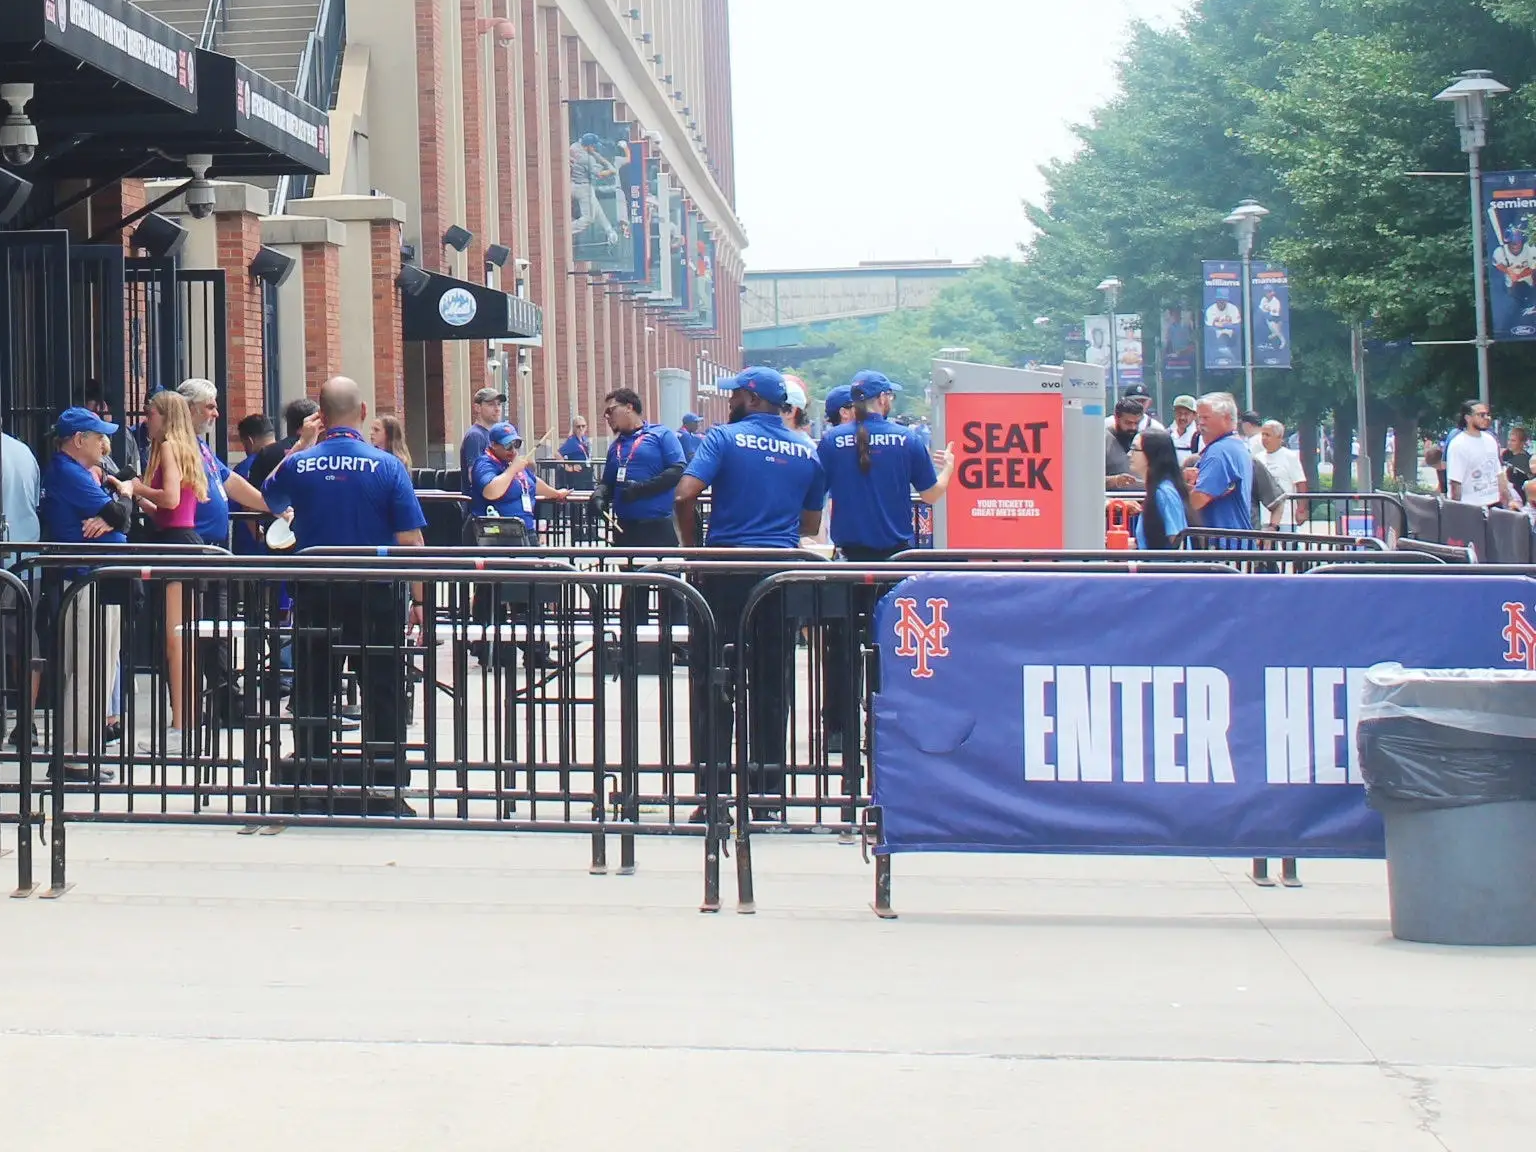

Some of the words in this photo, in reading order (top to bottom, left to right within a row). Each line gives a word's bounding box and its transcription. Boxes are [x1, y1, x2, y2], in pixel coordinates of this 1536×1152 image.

[1205, 278, 1240, 286] williams
[735, 433, 812, 459] SECURITY
[962, 421, 1049, 453] SEAT
[296, 455, 379, 474] SECURITY
[957, 458, 1053, 491] GEEK
[971, 508, 995, 516] GREAT
[976, 499, 997, 508] YOUR
[998, 499, 1022, 508] TICKET
[1023, 499, 1034, 508] TO
[1022, 664, 1235, 783] ENTER
[1264, 666, 1366, 784] HE
